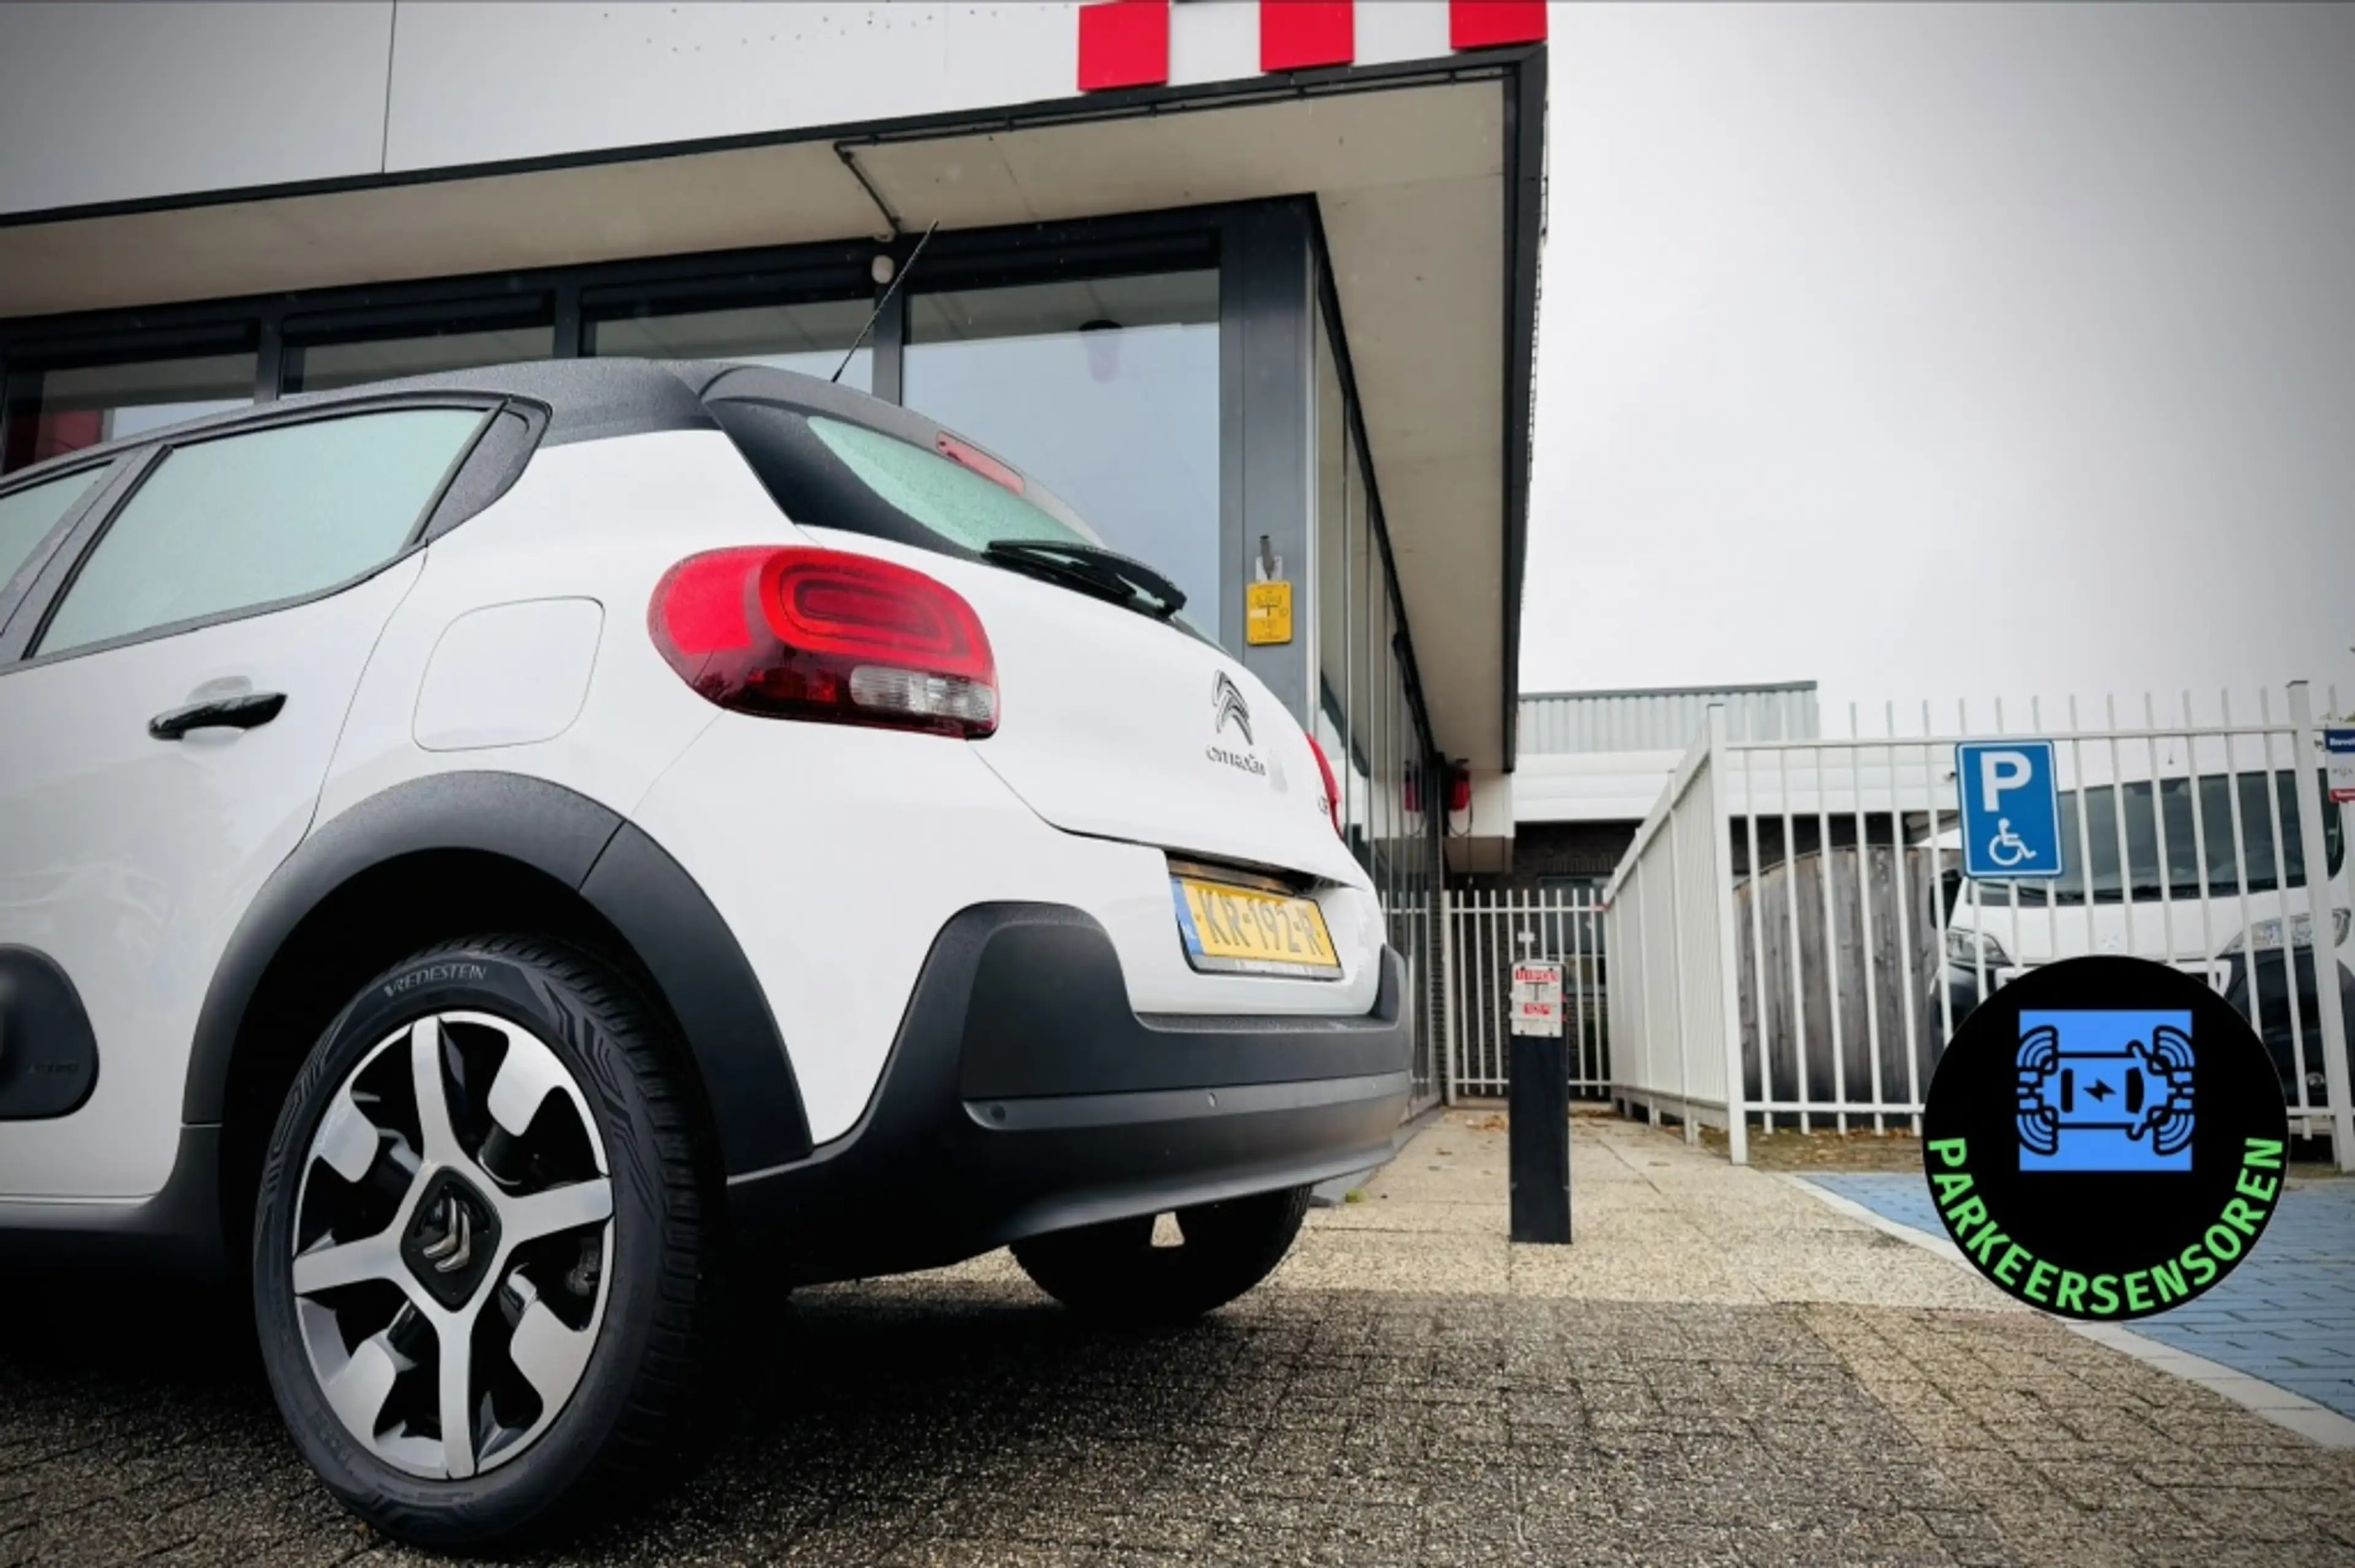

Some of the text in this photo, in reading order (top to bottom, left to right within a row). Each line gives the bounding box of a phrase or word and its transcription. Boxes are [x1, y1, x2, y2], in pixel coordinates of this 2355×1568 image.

[1980, 751, 2032, 812] P
[1197, 889, 1325, 956] KR-192-R
[383, 963, 487, 997] VREDESTEIN
